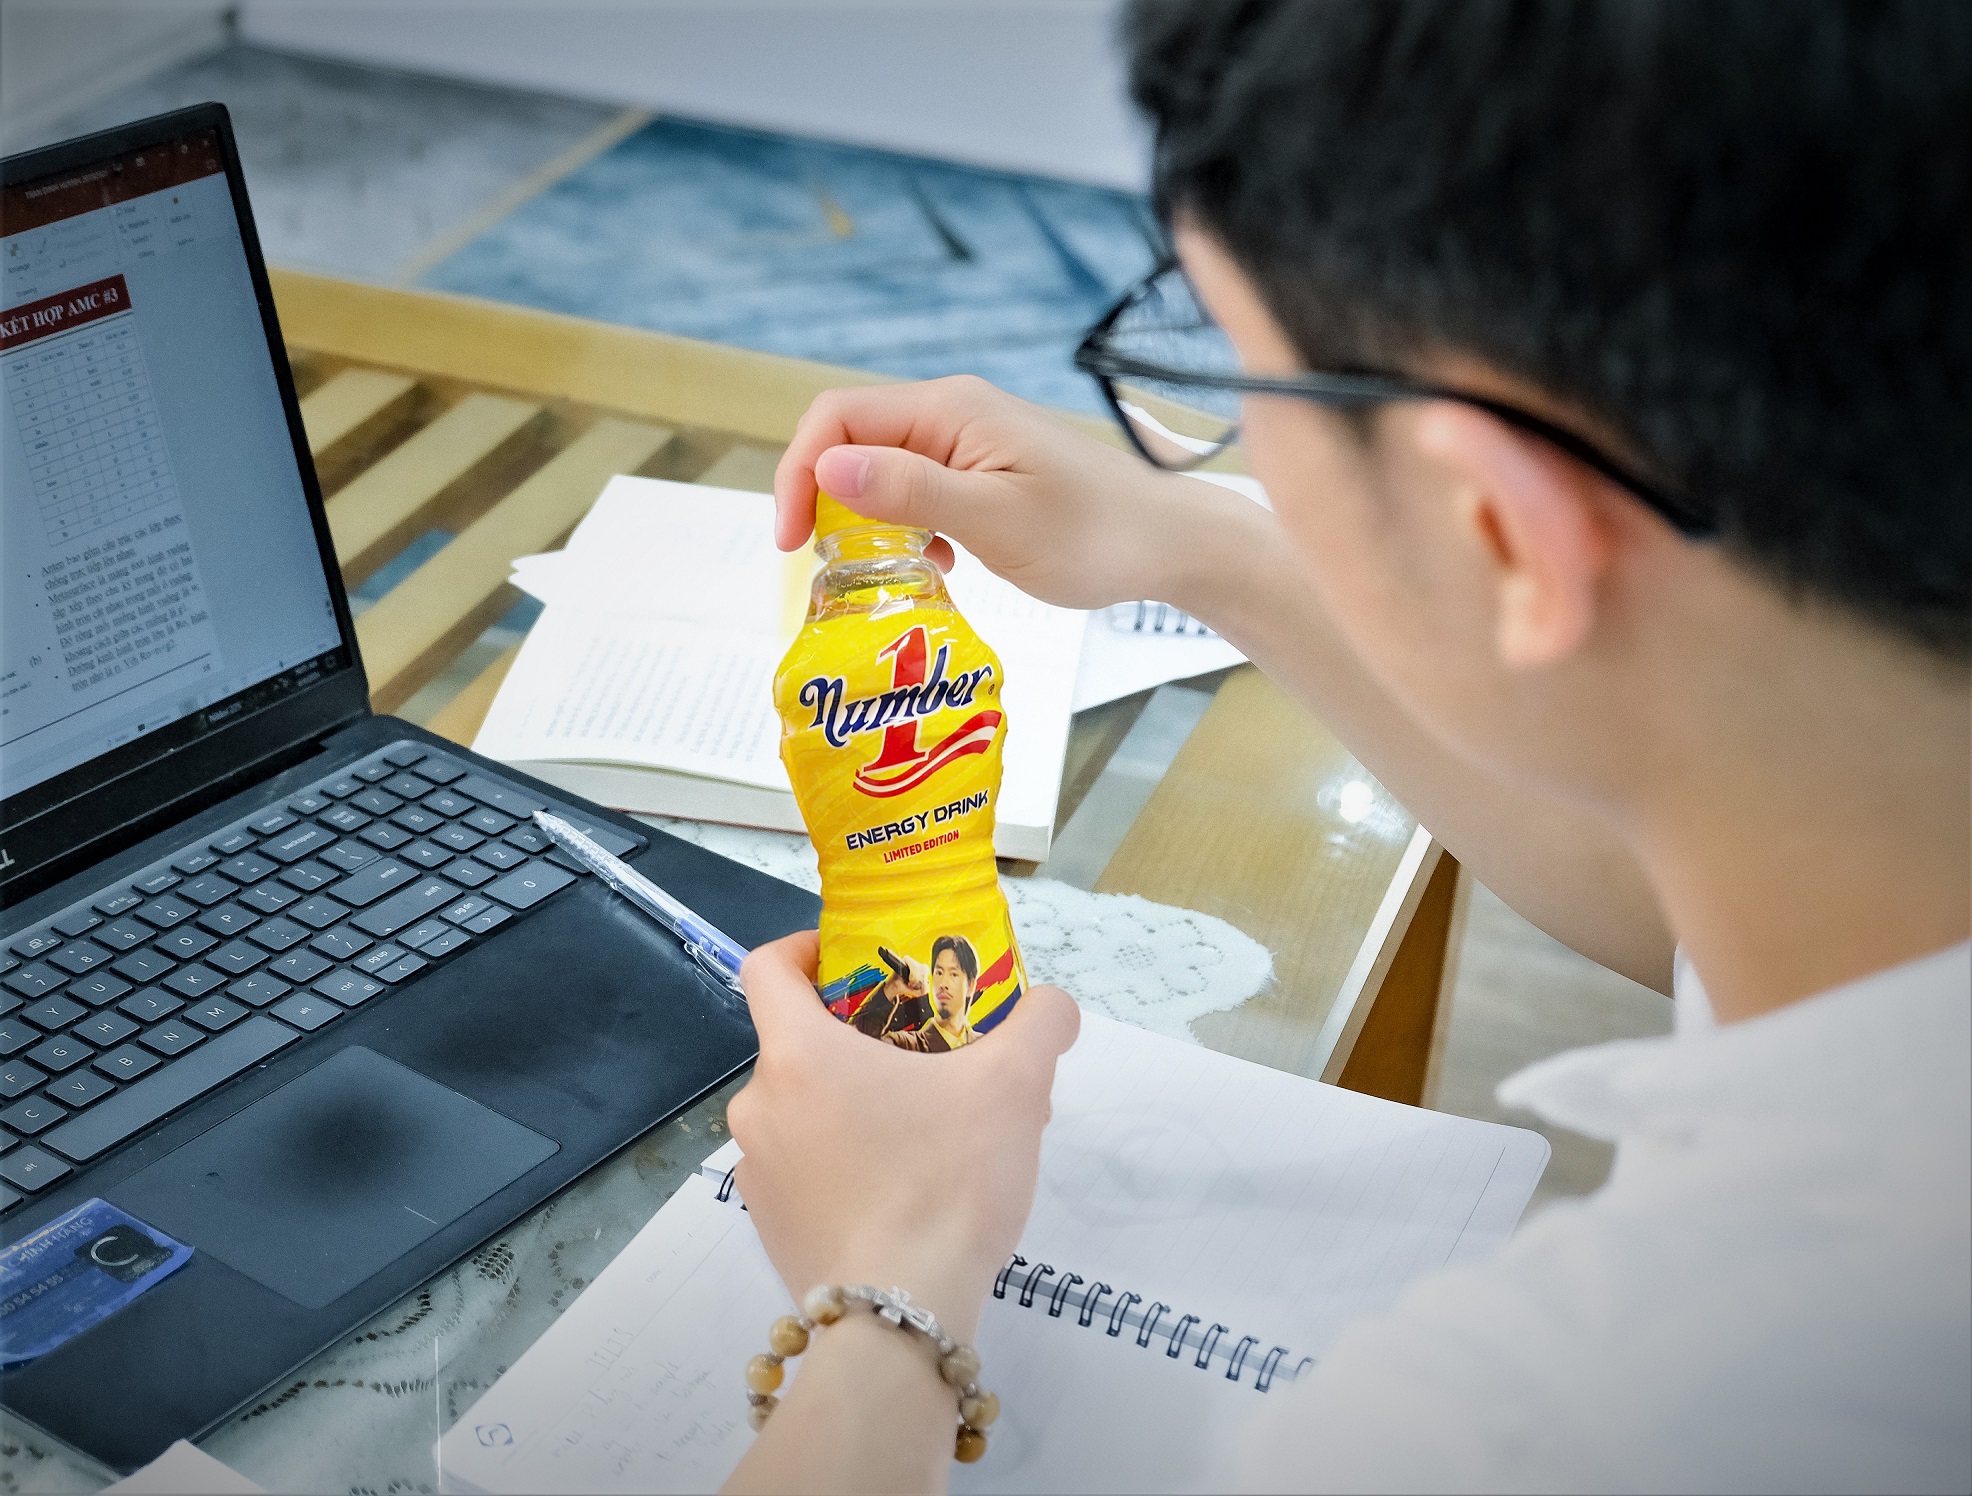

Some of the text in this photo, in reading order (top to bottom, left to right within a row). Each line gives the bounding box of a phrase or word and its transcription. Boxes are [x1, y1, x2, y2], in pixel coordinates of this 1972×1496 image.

[67, 292, 101, 317] AMC
[102, 287, 119, 304] #3
[845, 789, 989, 851] ENERGY DRINK
[378, 831, 390, 839] 7
[883, 829, 960, 864] LIMITED EDITION
[493, 851, 506, 859] 2
[461, 868, 473, 876] 1
[523, 880, 537, 888] 0
[425, 885, 442, 897] shift
[454, 906, 467, 917] pg
[221, 914, 232, 923] P
[179, 937, 193, 945] O
[229, 954, 244, 962] L
[368, 950, 389, 965] pg up
[187, 975, 201, 984] K
[91, 983, 106, 992] U
[340, 981, 355, 992] ctrl
[147, 999, 157, 1008] J
[46, 1007, 59, 1015] Y
[206, 1007, 225, 1018] M
[98, 1023, 113, 1033] H
[163, 1032, 179, 1042] N
[53, 1047, 68, 1057] G
[118, 1057, 134, 1067] B
[5, 1073, 17, 1083] F
[71, 1082, 86, 1091] V
[25, 1109, 40, 1118] C
[24, 1162, 38, 1172] alt
